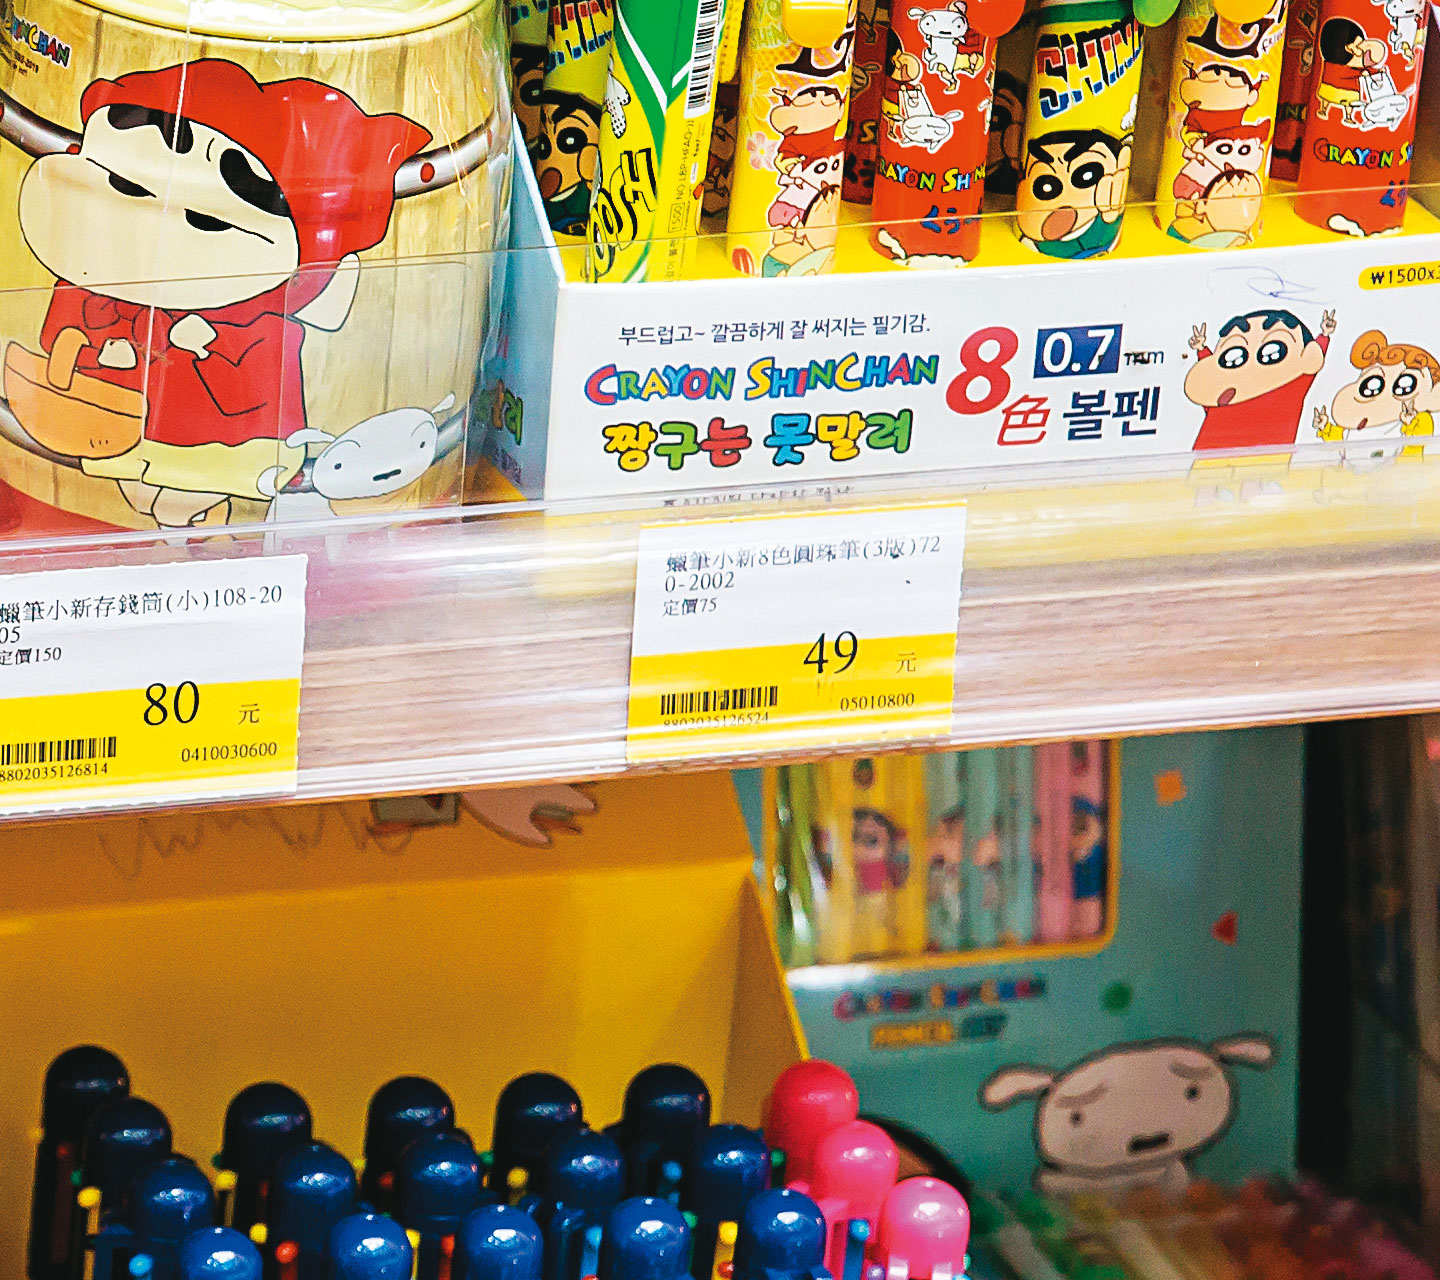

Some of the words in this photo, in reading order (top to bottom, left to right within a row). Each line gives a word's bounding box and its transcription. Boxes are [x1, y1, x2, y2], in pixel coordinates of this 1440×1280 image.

[711, 319, 785, 344] 깔끔하게
[789, 317, 808, 341] 잘
[811, 316, 868, 339] 써지는
[1042, 328, 1116, 374] 0.7
[585, 363, 735, 407] CRAYON
[744, 353, 940, 403] SHINCHAN
[945, 326, 1019, 415] 8
[997, 394, 1051, 447] 色
[1061, 386, 1161, 441] 볼펜
[603, 417, 751, 472] 짱구는
[765, 408, 913, 466] 못말려
[664, 571, 735, 593] 0-2002
[803, 631, 859, 675] 49
[895, 651, 917, 674] 元
[143, 680, 200, 726] 80
[238, 704, 260, 726] 元
[840, 692, 915, 711] 05010800
[181, 742, 278, 763] 0410030600
